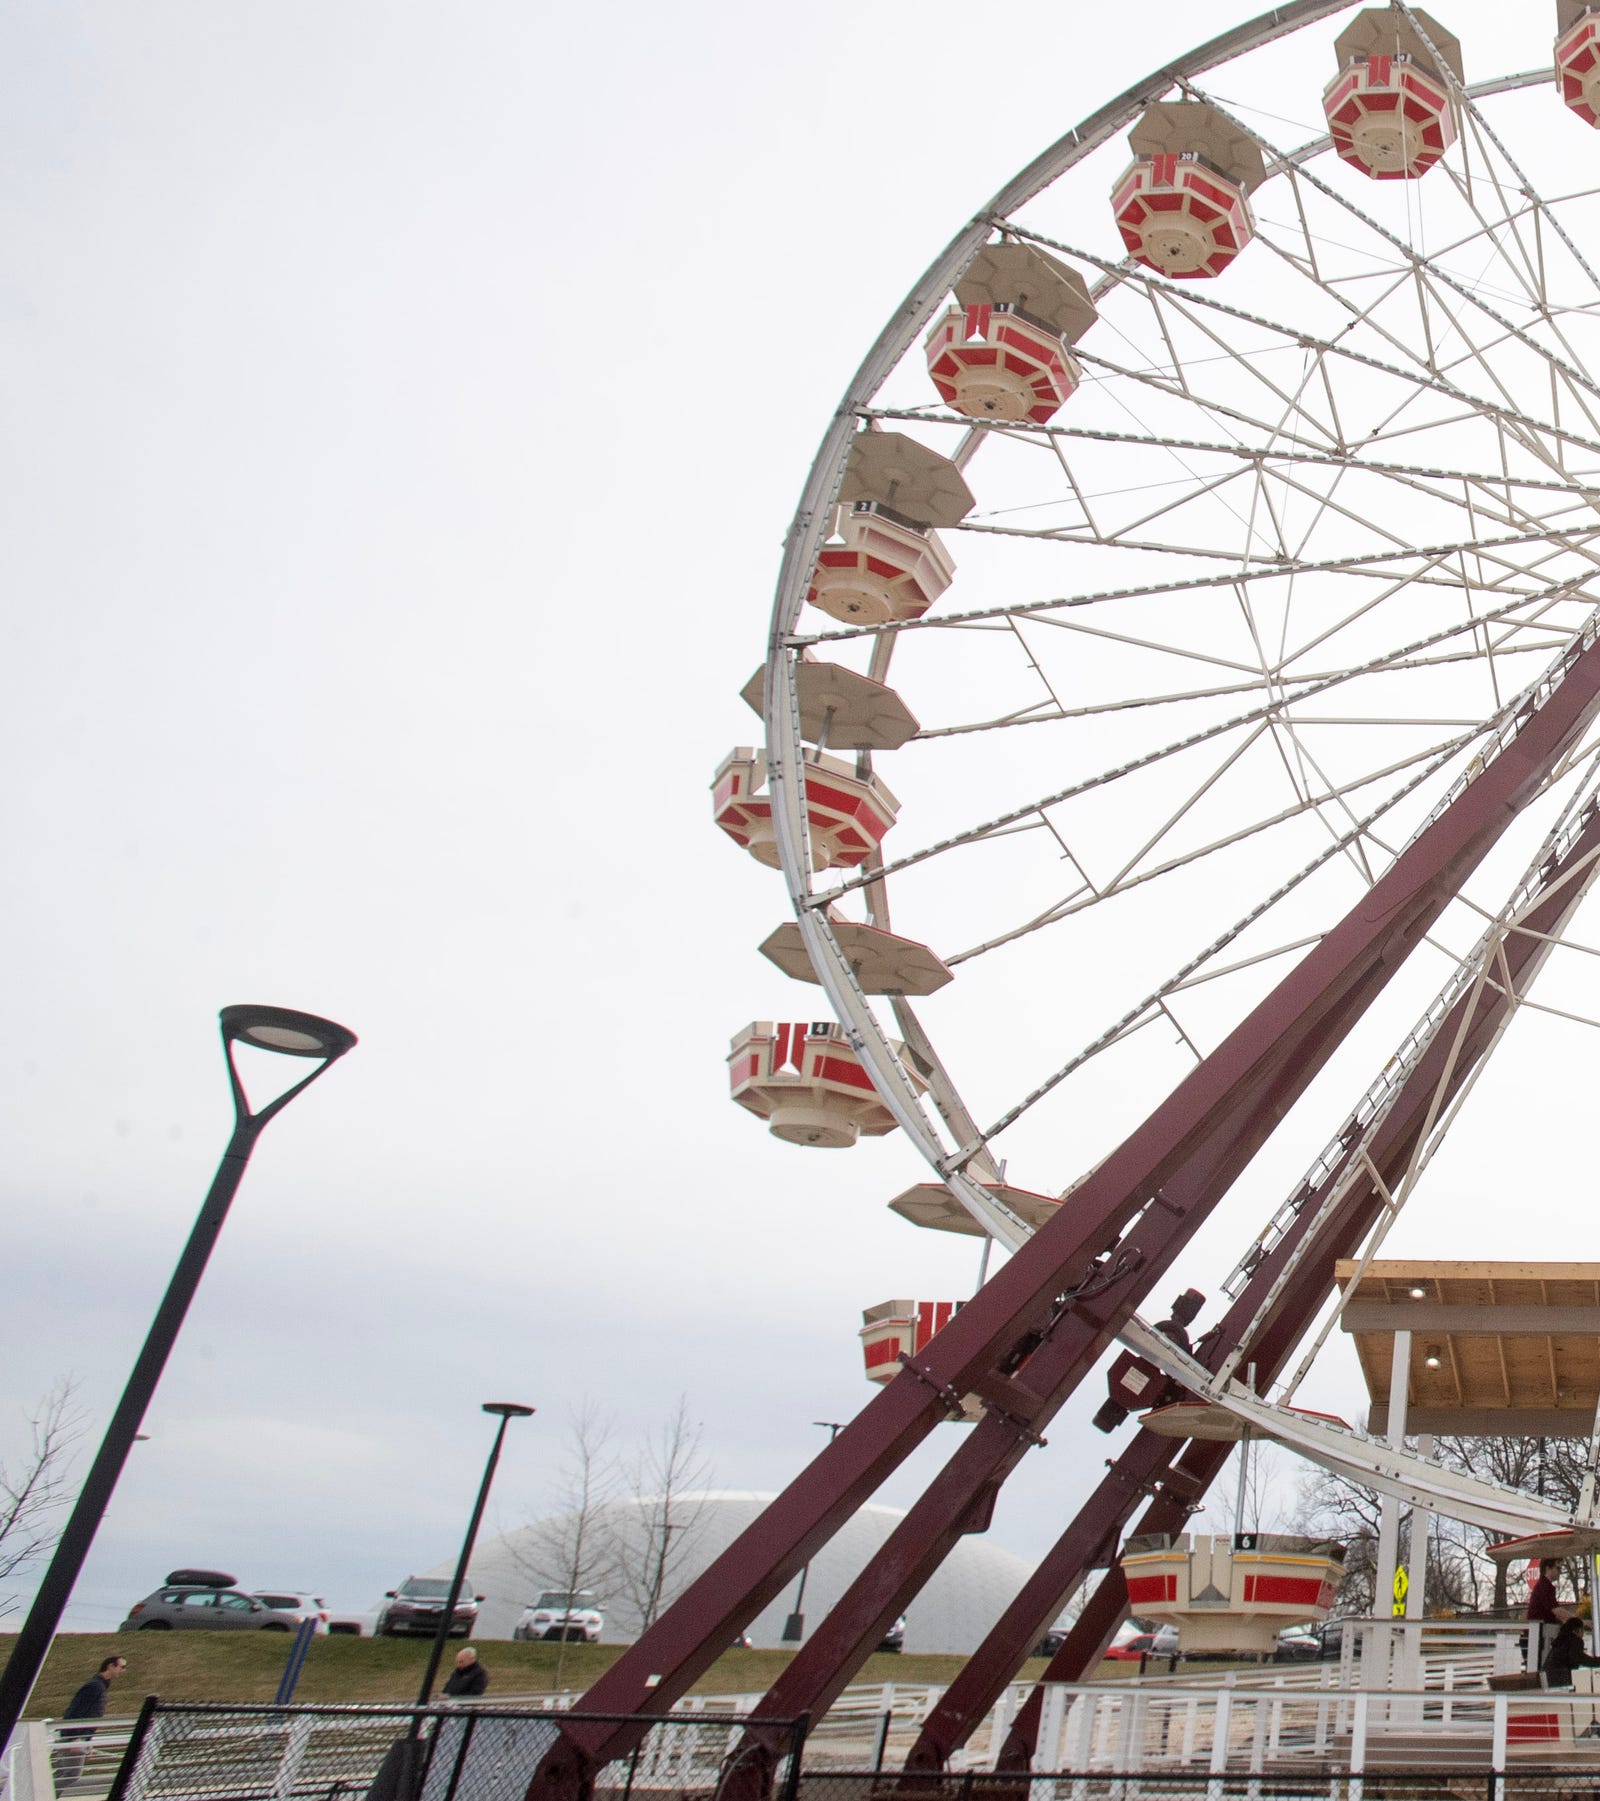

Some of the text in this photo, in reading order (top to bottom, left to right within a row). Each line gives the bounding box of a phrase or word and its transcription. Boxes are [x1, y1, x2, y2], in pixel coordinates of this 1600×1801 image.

[1180, 152, 1192, 161] 20
[860, 502, 868, 511] 2
[815, 1023, 824, 1034] 4
[1241, 1535, 1251, 1549] 6
[1526, 1567, 1540, 1580] STO
